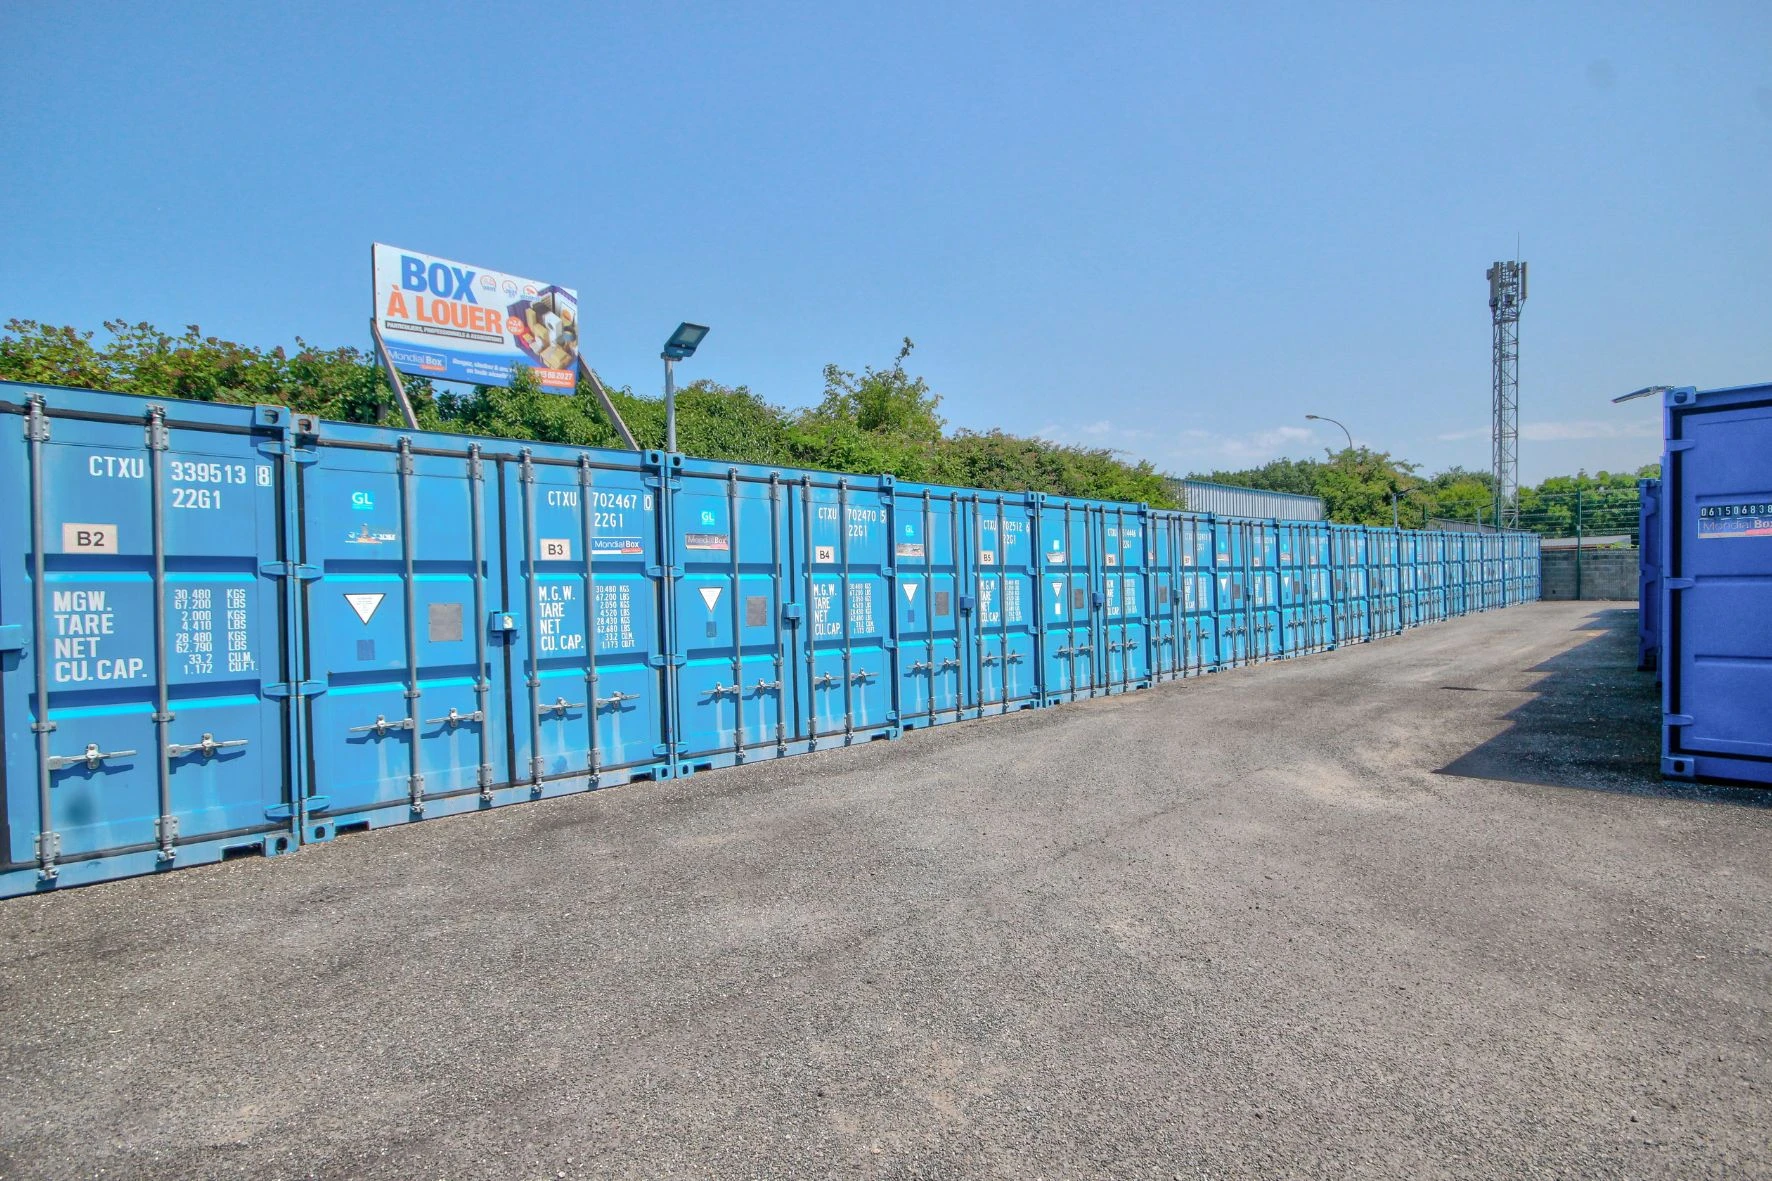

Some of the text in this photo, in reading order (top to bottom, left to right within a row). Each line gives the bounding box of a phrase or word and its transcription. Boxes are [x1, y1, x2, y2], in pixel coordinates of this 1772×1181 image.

[400, 254, 478, 304] BOX
[386, 284, 409, 319] À
[416, 295, 502, 334] LOUER
[89, 456, 271, 486] CTXU 339513 8
[172, 488, 222, 510] 22G1
[352, 492, 373, 505] GL
[548, 490, 577, 506] CTXU
[592, 492, 637, 509] 702467
[594, 512, 623, 528] 22G1
[702, 512, 714, 521] GL
[818, 507, 837, 520] CTXU
[848, 508, 876, 522] 702470
[848, 525, 867, 537] 22G1
[77, 530, 105, 547] B2
[548, 544, 564, 556] B3
[820, 550, 830, 560] B4
[175, 588, 246, 600] 30.480 KGS
[538, 586, 576, 601] M.G.W.
[54, 590, 113, 612] MGW.
[175, 599, 246, 610] 67.200 LBS
[814, 597, 830, 609] TARE
[182, 610, 246, 621] 2.000 KGS
[539, 602, 565, 618] TARE
[814, 610, 828, 622] NET
[54, 614, 114, 636] TARE
[182, 620, 246, 631] 4.410 LBS
[540, 618, 560, 634] NET
[176, 631, 246, 642] 28.480 KGS
[54, 636, 101, 659] NET
[176, 641, 247, 653] 62.790 LBS
[189, 654, 212, 664] 33.2
[184, 664, 212, 674] 1.172
